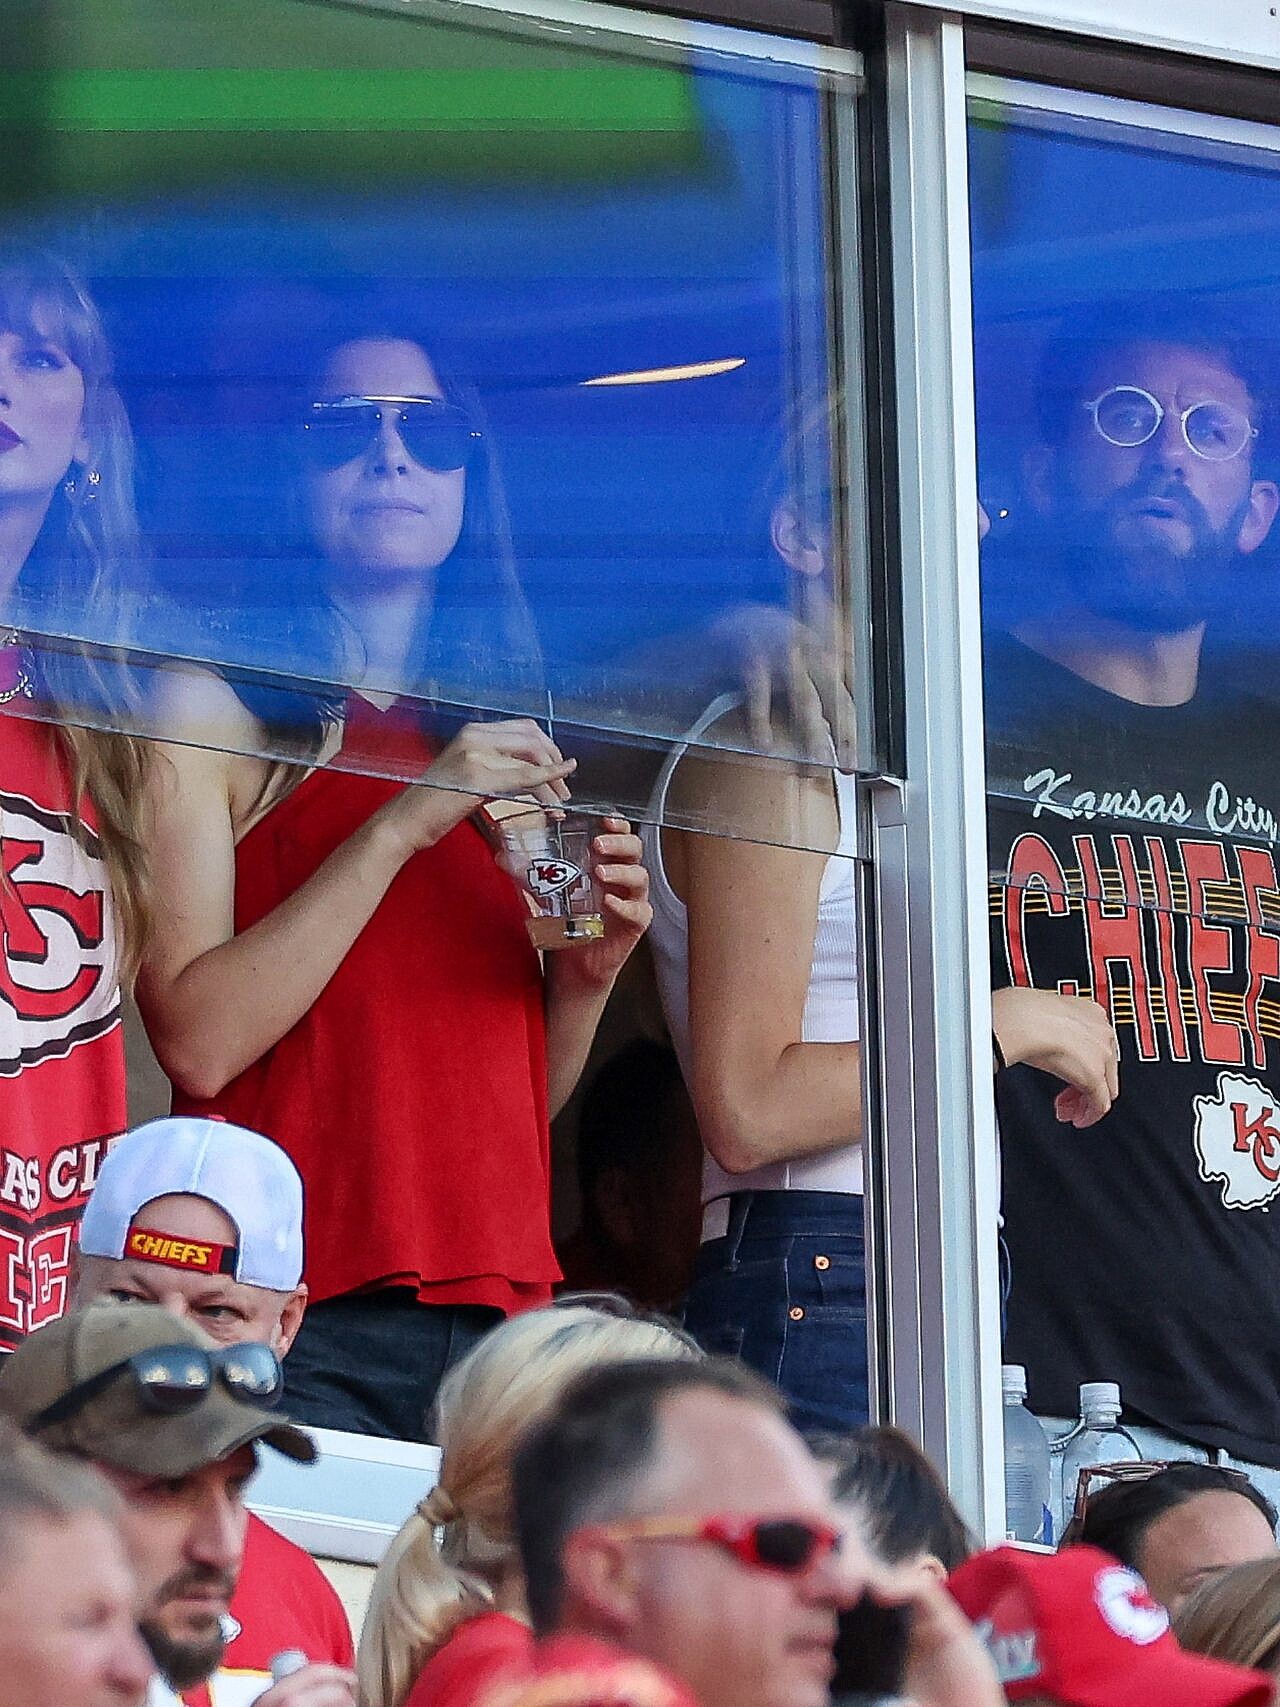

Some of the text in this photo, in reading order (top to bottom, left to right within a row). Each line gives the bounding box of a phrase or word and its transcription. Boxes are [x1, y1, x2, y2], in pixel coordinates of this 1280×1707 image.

[1024, 768, 1277, 849] Kansas City
[535, 863, 568, 885] KC
[1003, 832, 1280, 1070] CHIEF
[49, 1132, 127, 1199] CI
[131, 1233, 213, 1266] CHIEFS
